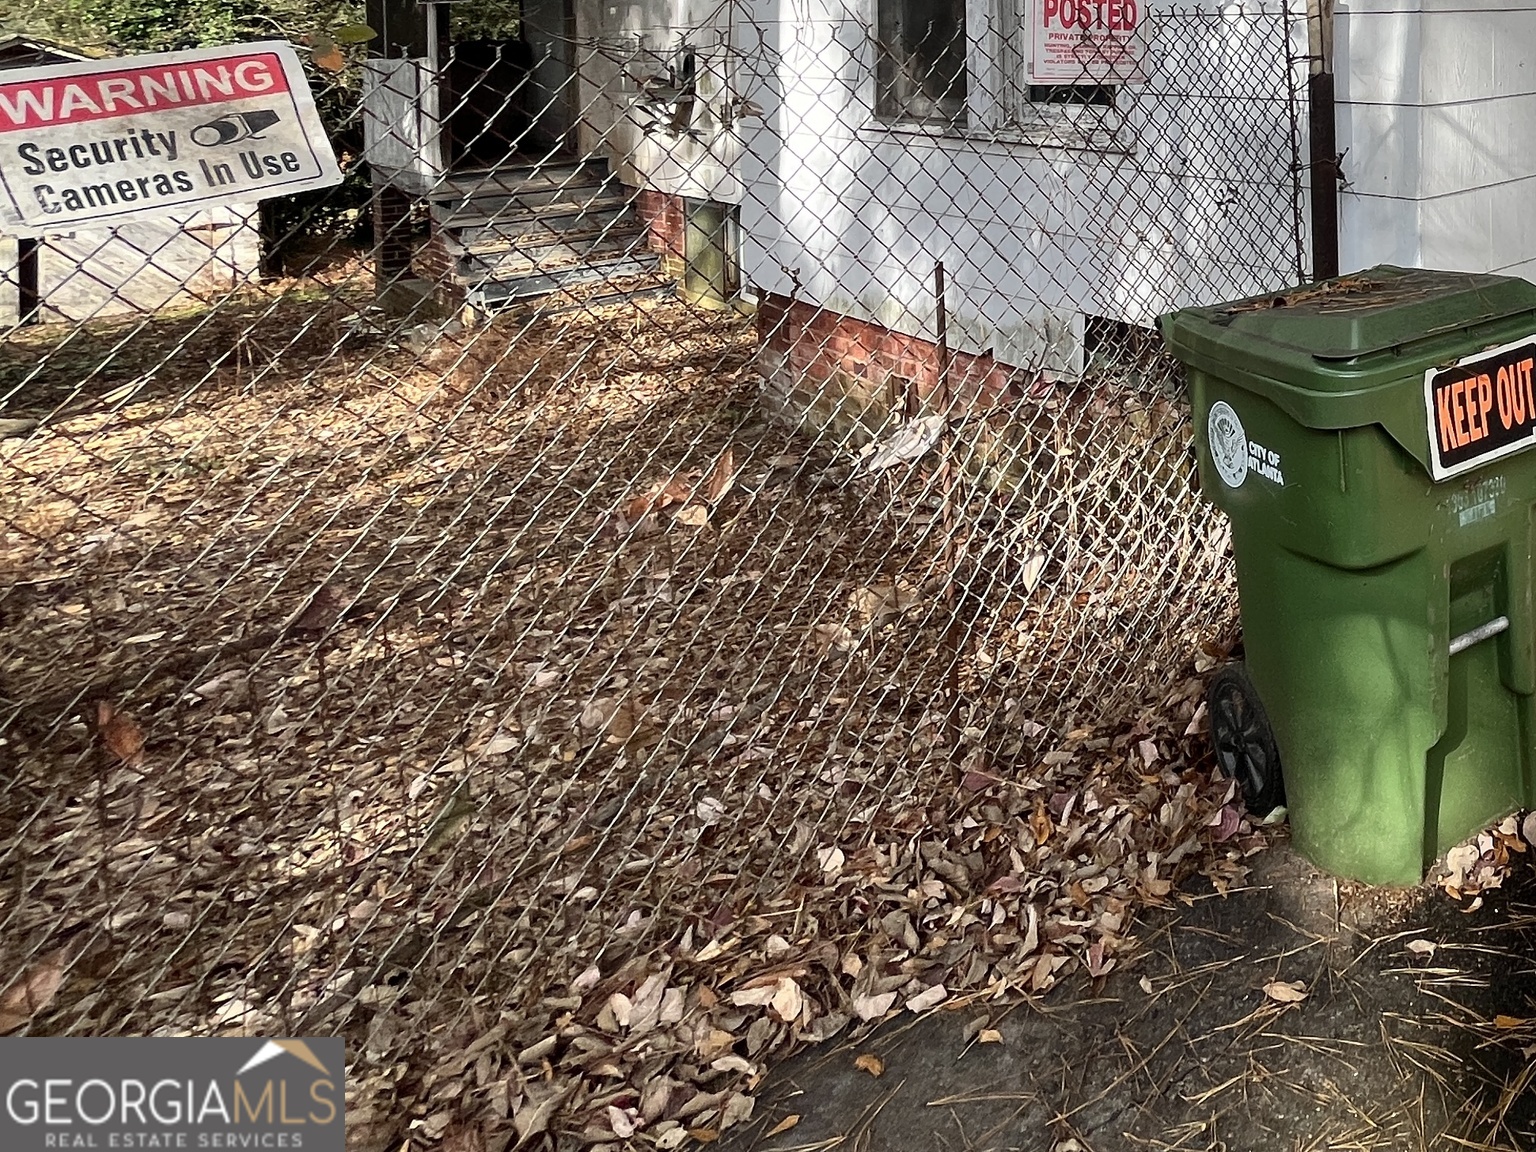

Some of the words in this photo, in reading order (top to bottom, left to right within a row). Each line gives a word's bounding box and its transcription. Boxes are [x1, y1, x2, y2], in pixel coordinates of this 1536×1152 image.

[1048, 32, 1085, 41] PRIVATE
[0, 60, 275, 125] WARNING
[18, 129, 180, 176] Security
[33, 169, 194, 215] Cameras
[199, 158, 235, 187] In
[239, 149, 301, 180] Use
[1437, 372, 1493, 453] KEEP
[1496, 357, 1536, 431] OUT
[1247, 454, 1285, 487] ATLANTA
[1248, 440, 1267, 461] CITY
[1267, 450, 1281, 467] OF
